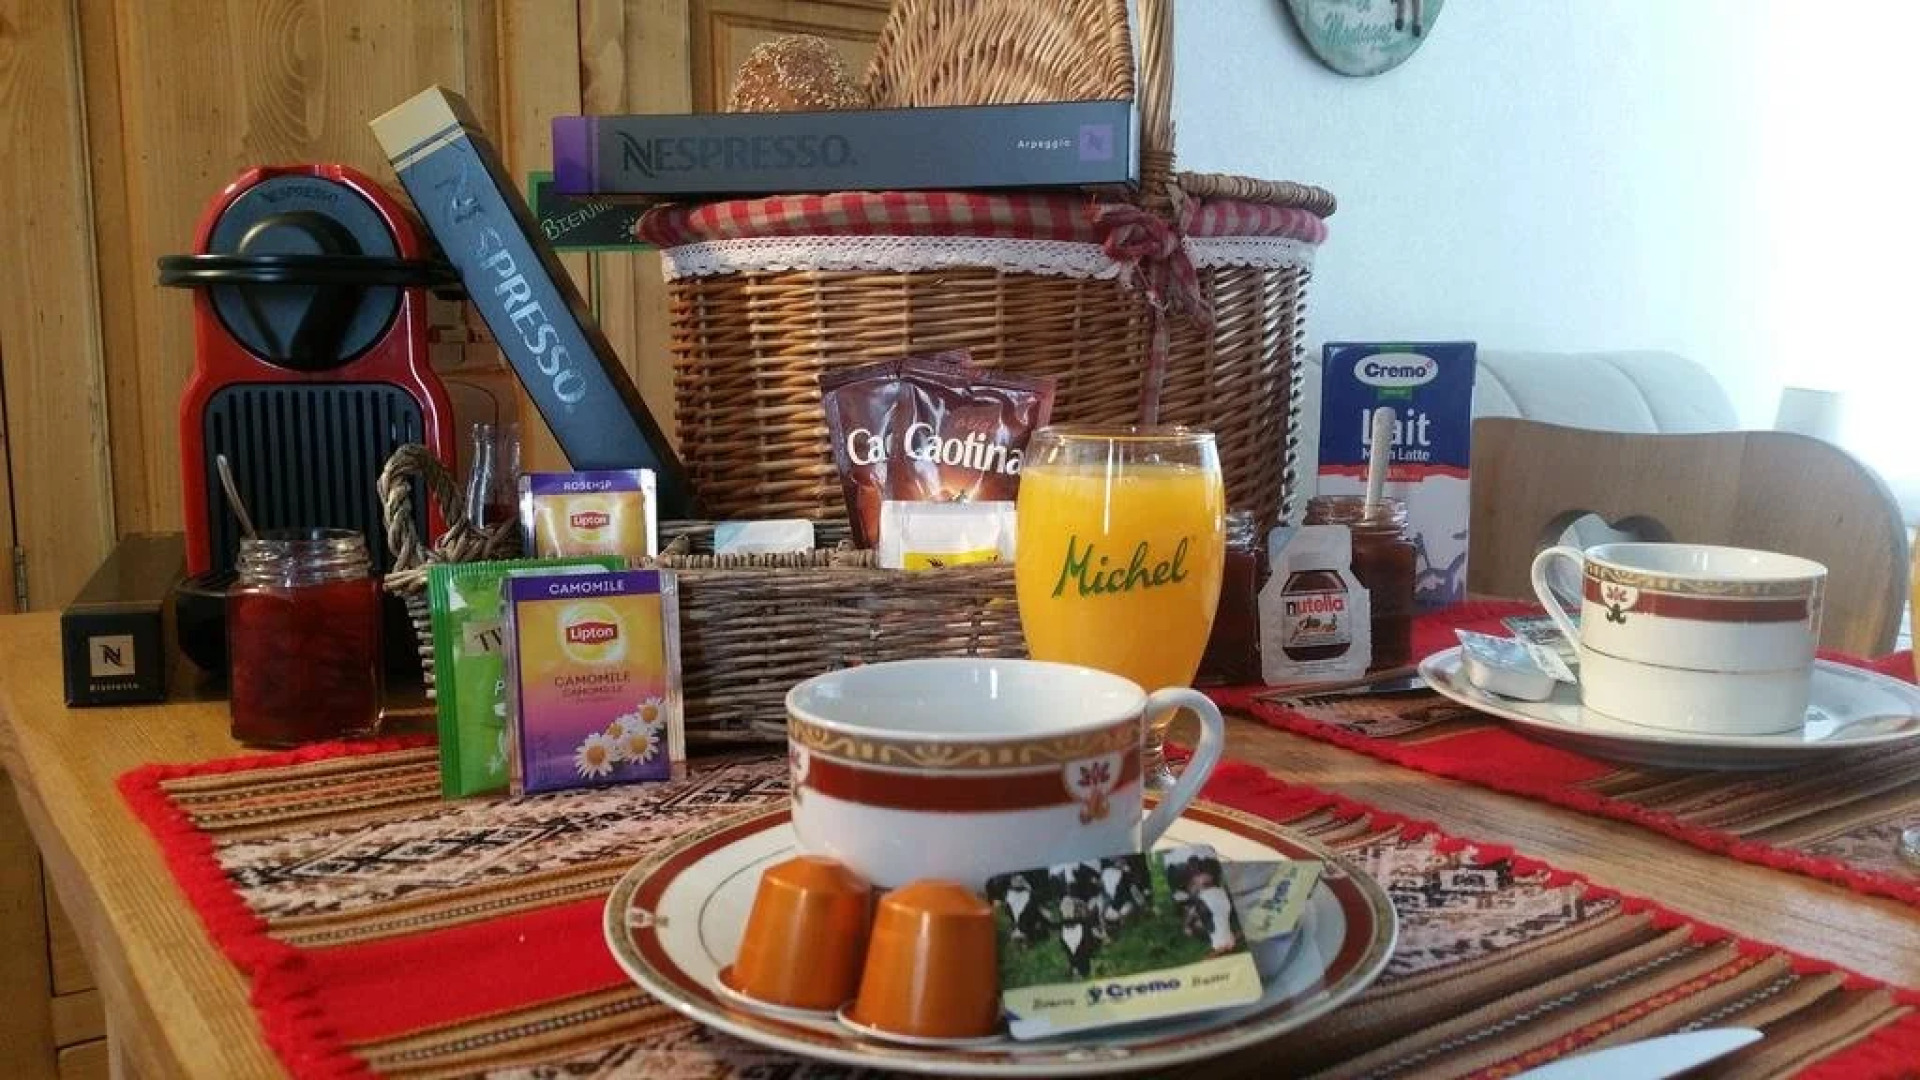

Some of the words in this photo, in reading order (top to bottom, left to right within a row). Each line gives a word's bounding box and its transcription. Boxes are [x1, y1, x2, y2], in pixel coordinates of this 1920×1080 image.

[617, 130, 856, 179] NESPRESSO
[1364, 362, 1427, 378] Cremo
[904, 421, 1024, 475] Caotina
[573, 515, 606, 526] Lipton
[1051, 534, 1189, 598] Michel
[549, 579, 625, 595] CAMOMILE
[1286, 594, 1345, 616] nutella
[570, 623, 614, 643] Lipton
[1106, 978, 1182, 999] Cremo
